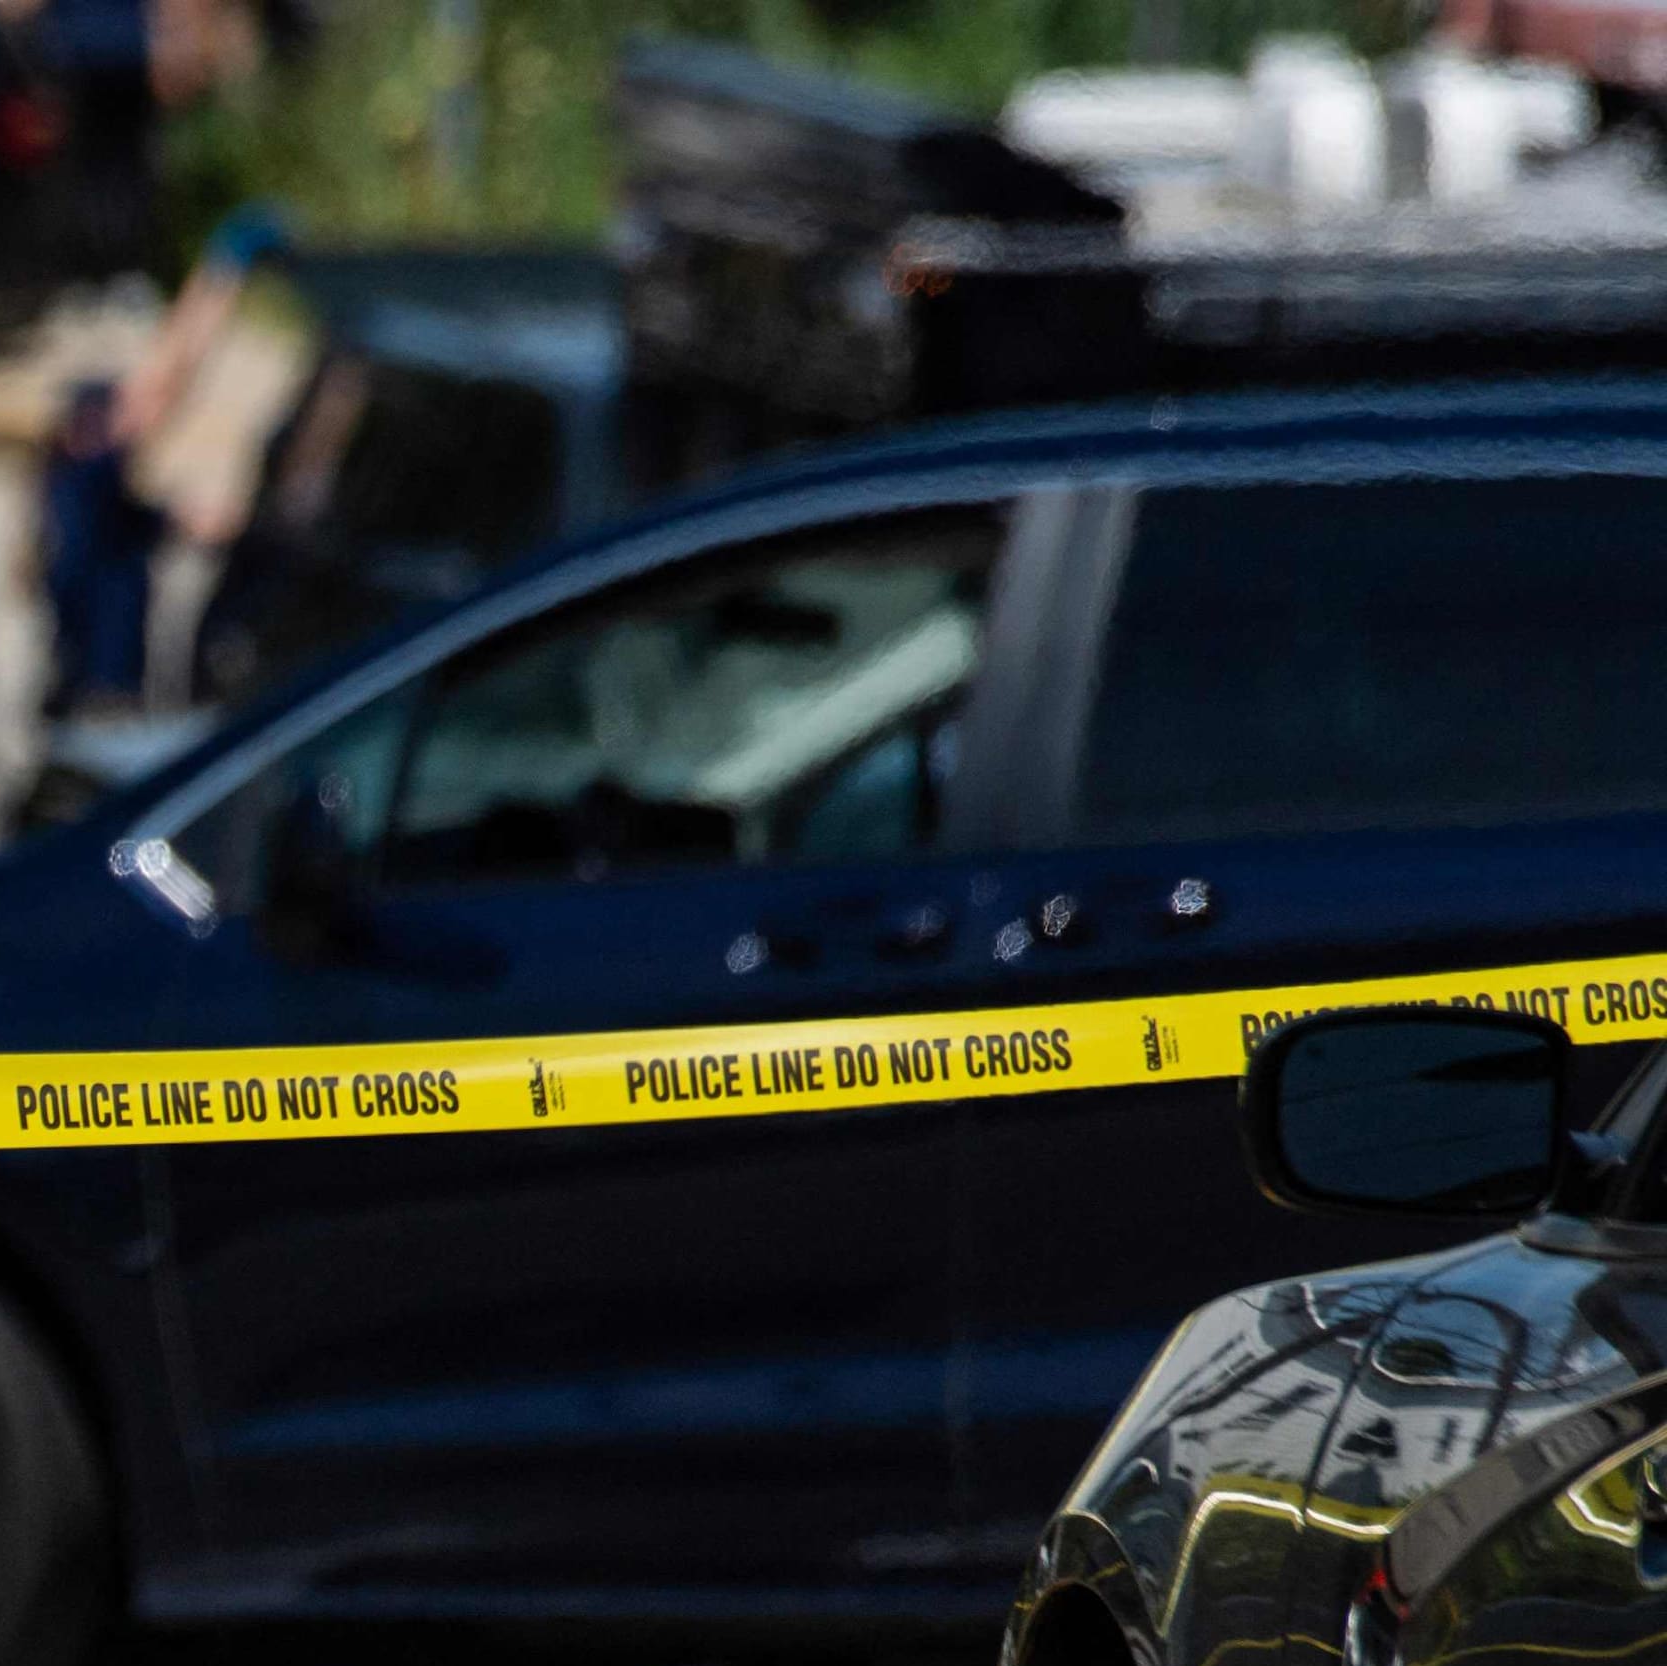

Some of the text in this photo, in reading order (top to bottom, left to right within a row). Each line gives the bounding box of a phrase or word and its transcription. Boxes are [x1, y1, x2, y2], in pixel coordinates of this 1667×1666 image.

[1583, 978, 1667, 1025] CROS
[626, 1029, 1071, 1103] POLICE LINE DO NOT CROSS
[17, 1071, 459, 1129] POLICE LINE DO NOT CROSS
